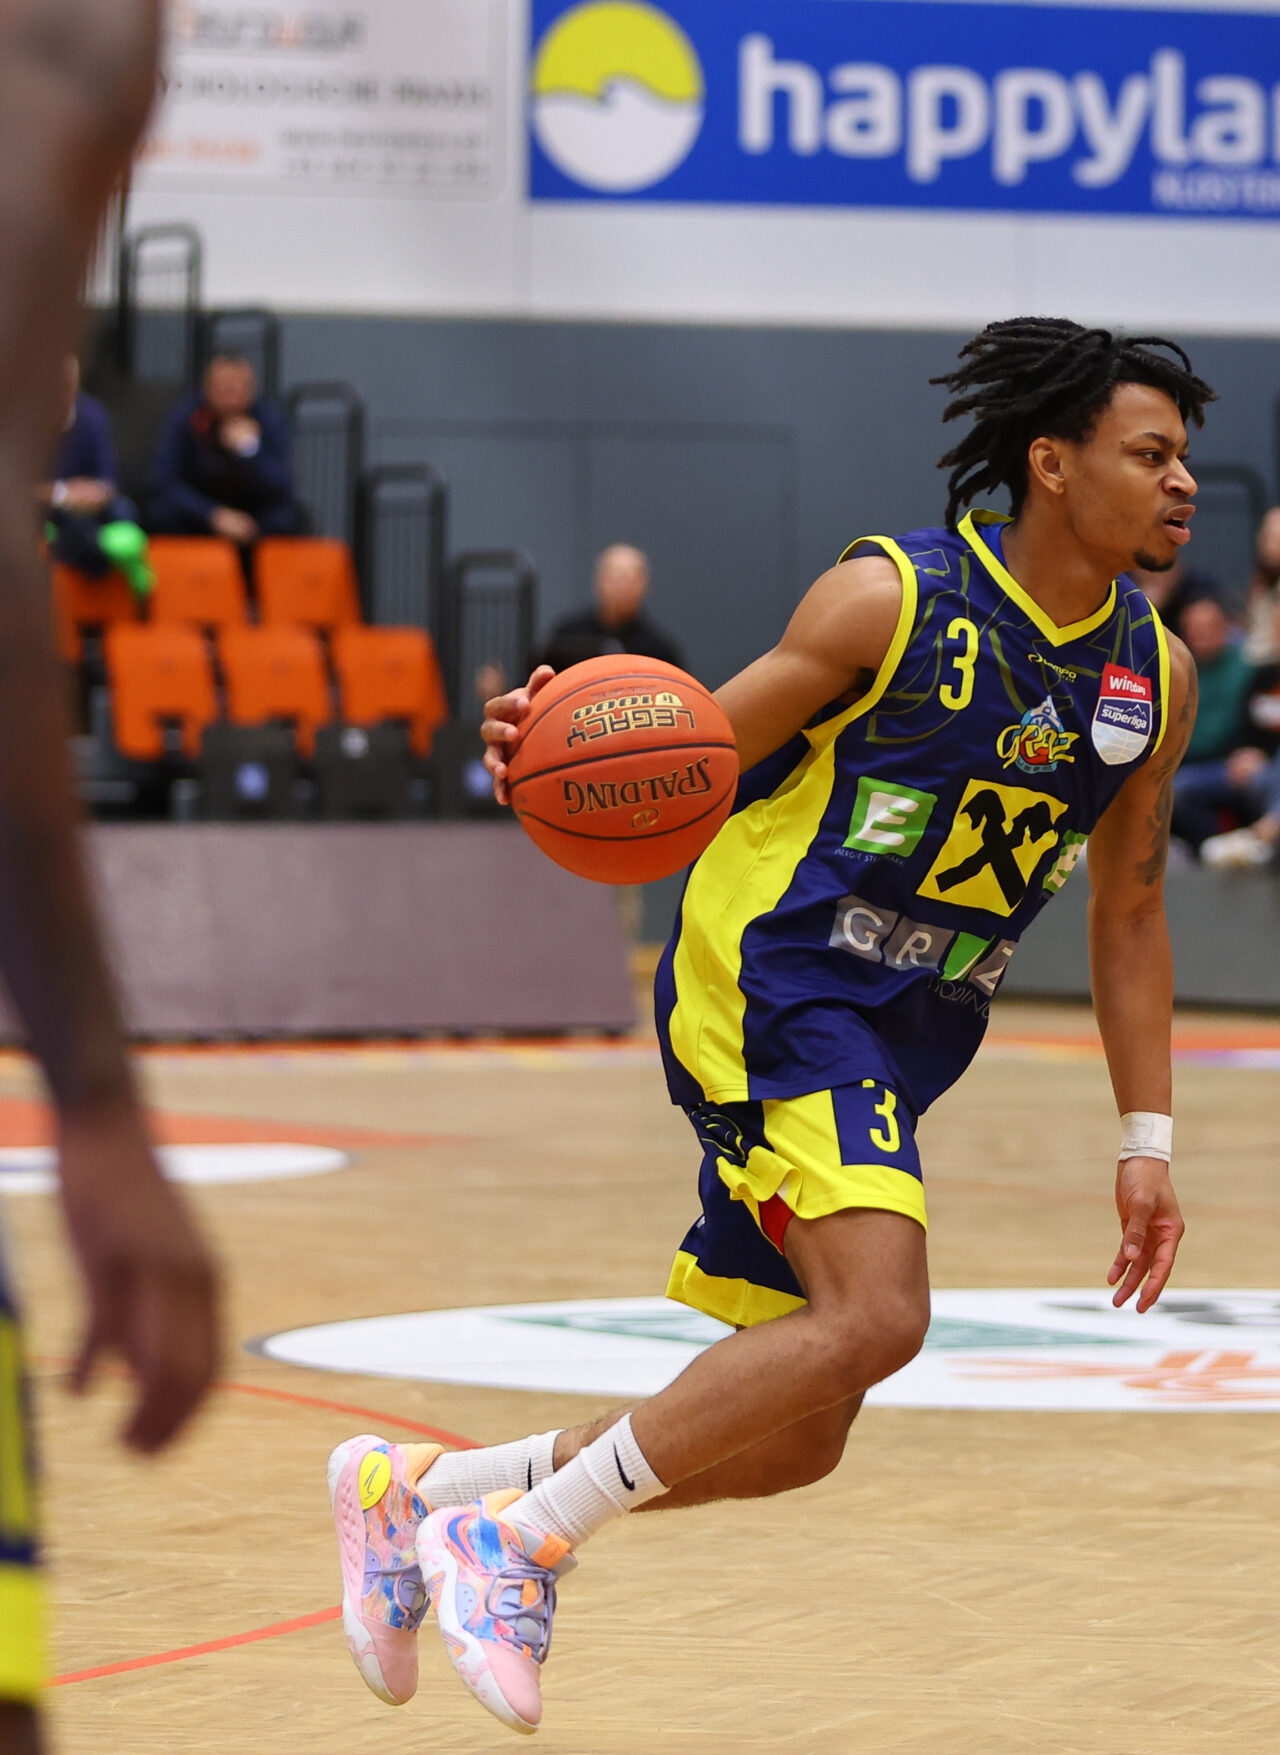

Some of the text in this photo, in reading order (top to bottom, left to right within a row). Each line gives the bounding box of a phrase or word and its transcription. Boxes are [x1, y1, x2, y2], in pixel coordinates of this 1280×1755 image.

[939, 617, 979, 711] 3
[567, 707, 695, 749] LEGACY
[573, 694, 653, 721] 1000
[1101, 708, 1147, 730] superliga
[564, 756, 712, 815] SPALDING
[869, 1079, 901, 1153] 3
